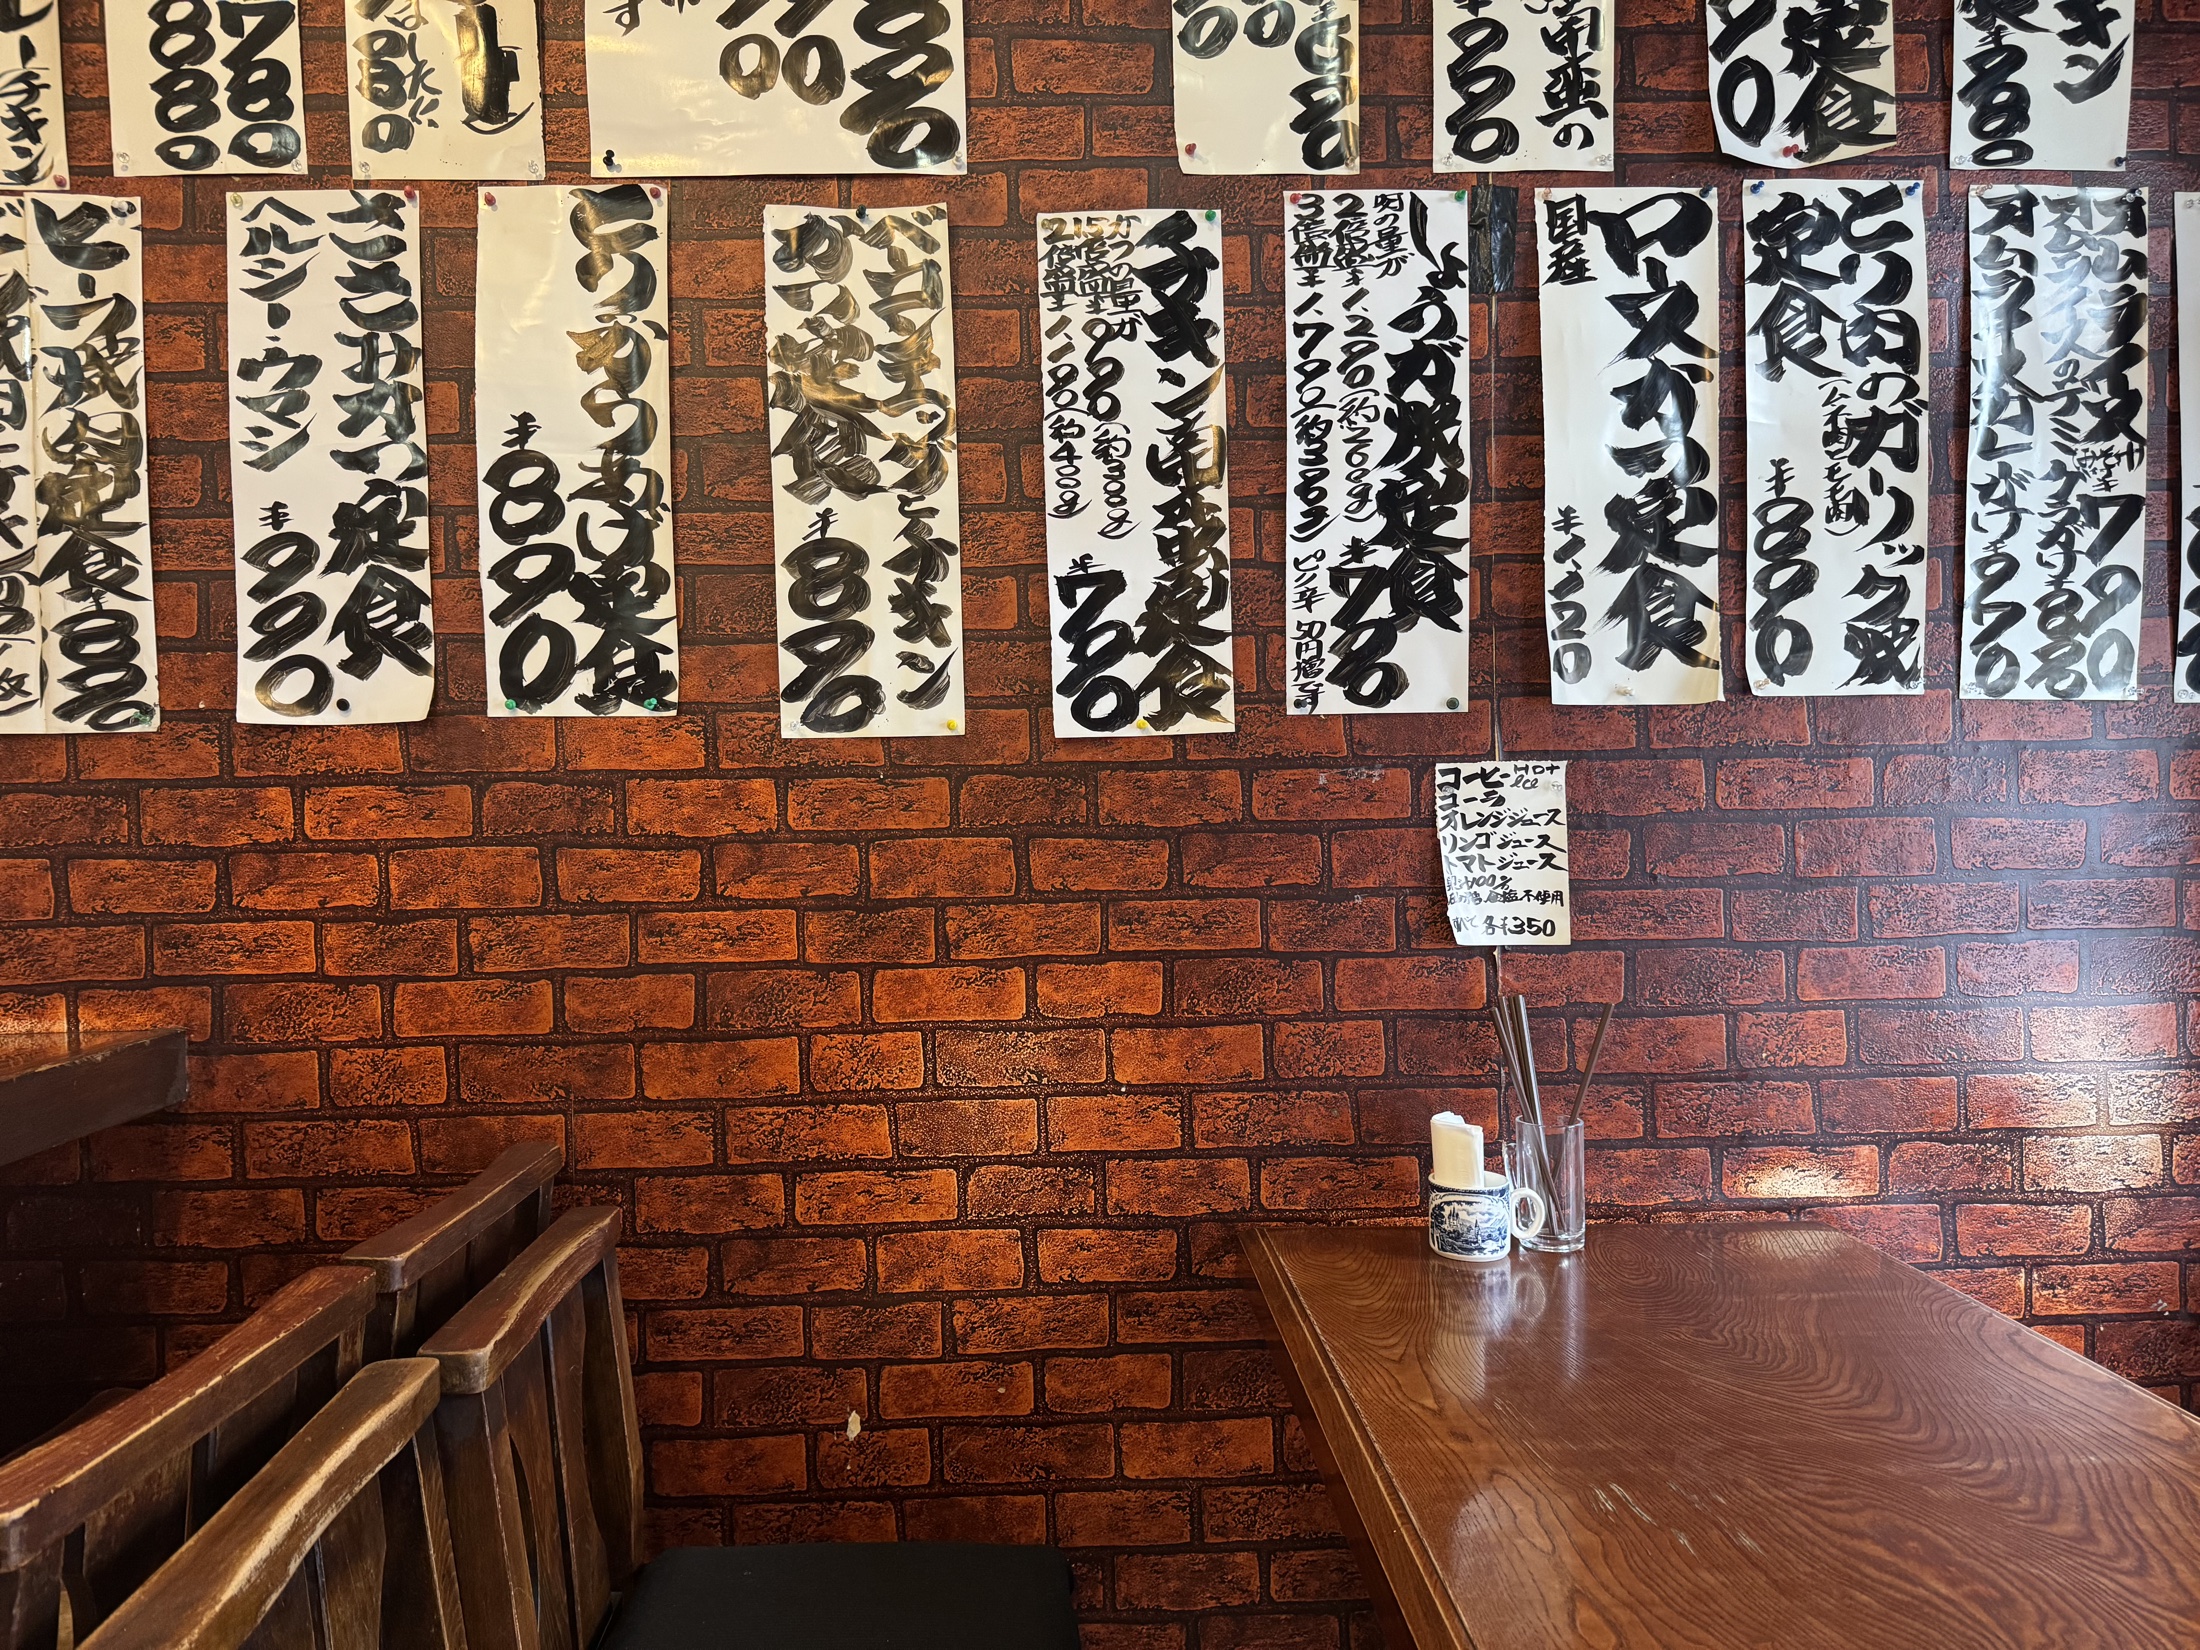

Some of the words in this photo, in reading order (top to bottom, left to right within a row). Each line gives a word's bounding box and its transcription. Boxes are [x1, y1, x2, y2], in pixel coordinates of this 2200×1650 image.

[1542, 195, 1599, 286] 国産
[1745, 191, 1847, 385] 定食
[1438, 789, 1506, 812] コーラ
[1438, 807, 1566, 832] オレンジジュース
[1442, 830, 1567, 854] リンゴジュース
[1443, 852, 1568, 875] トマトジュース
